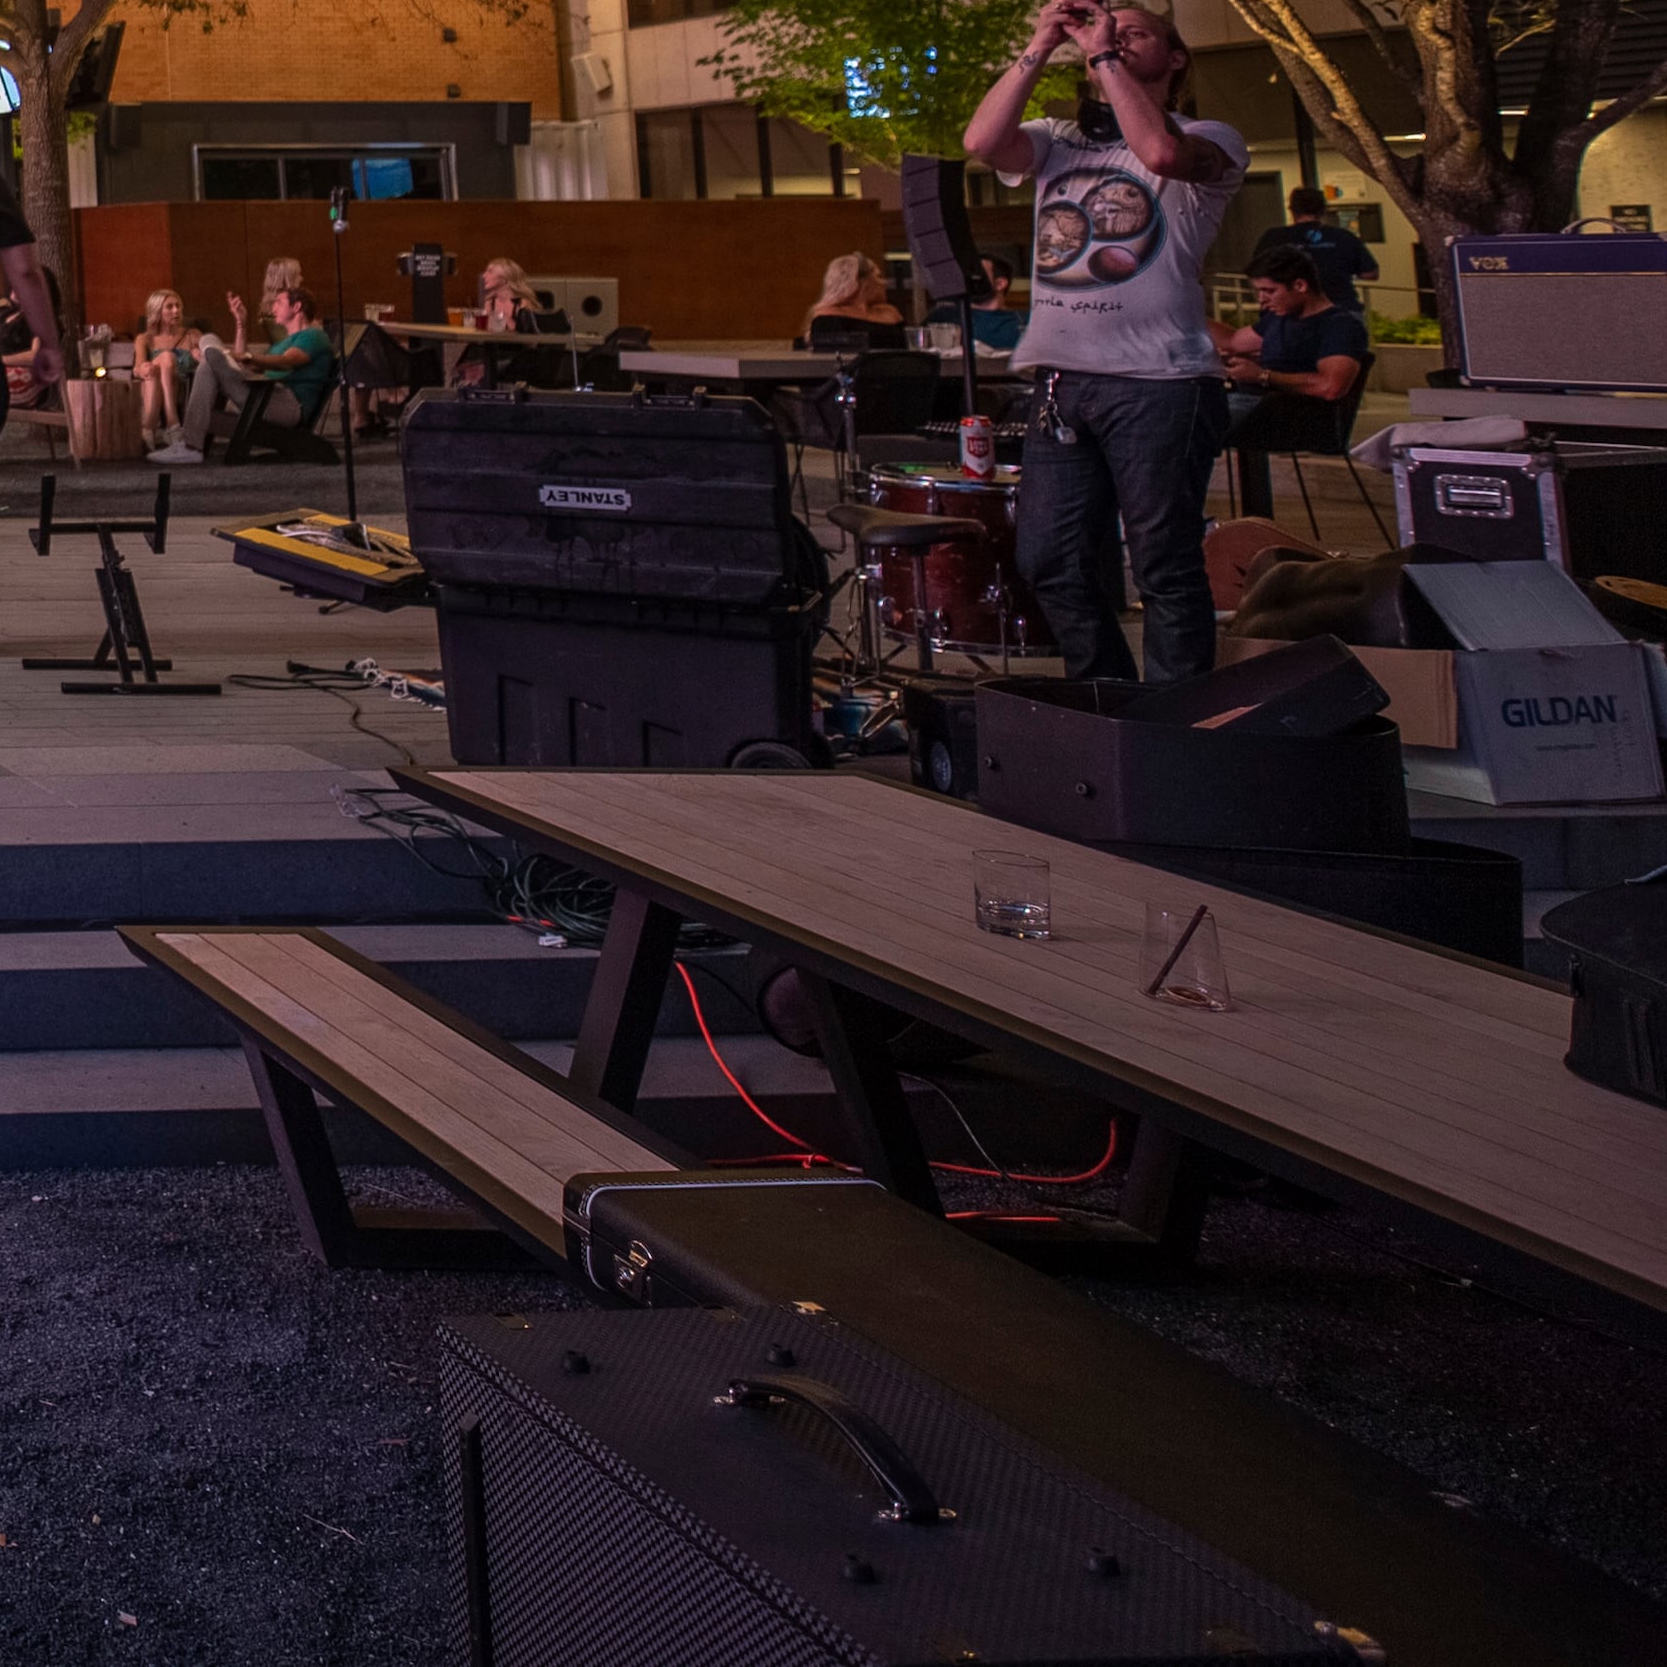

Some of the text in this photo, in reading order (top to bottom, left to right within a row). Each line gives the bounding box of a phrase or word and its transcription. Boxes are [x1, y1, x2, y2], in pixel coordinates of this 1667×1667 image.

[1468, 256, 1509, 270] VOX
[547, 490, 625, 505] STANLEY
[1501, 695, 1617, 727] GILDAN
